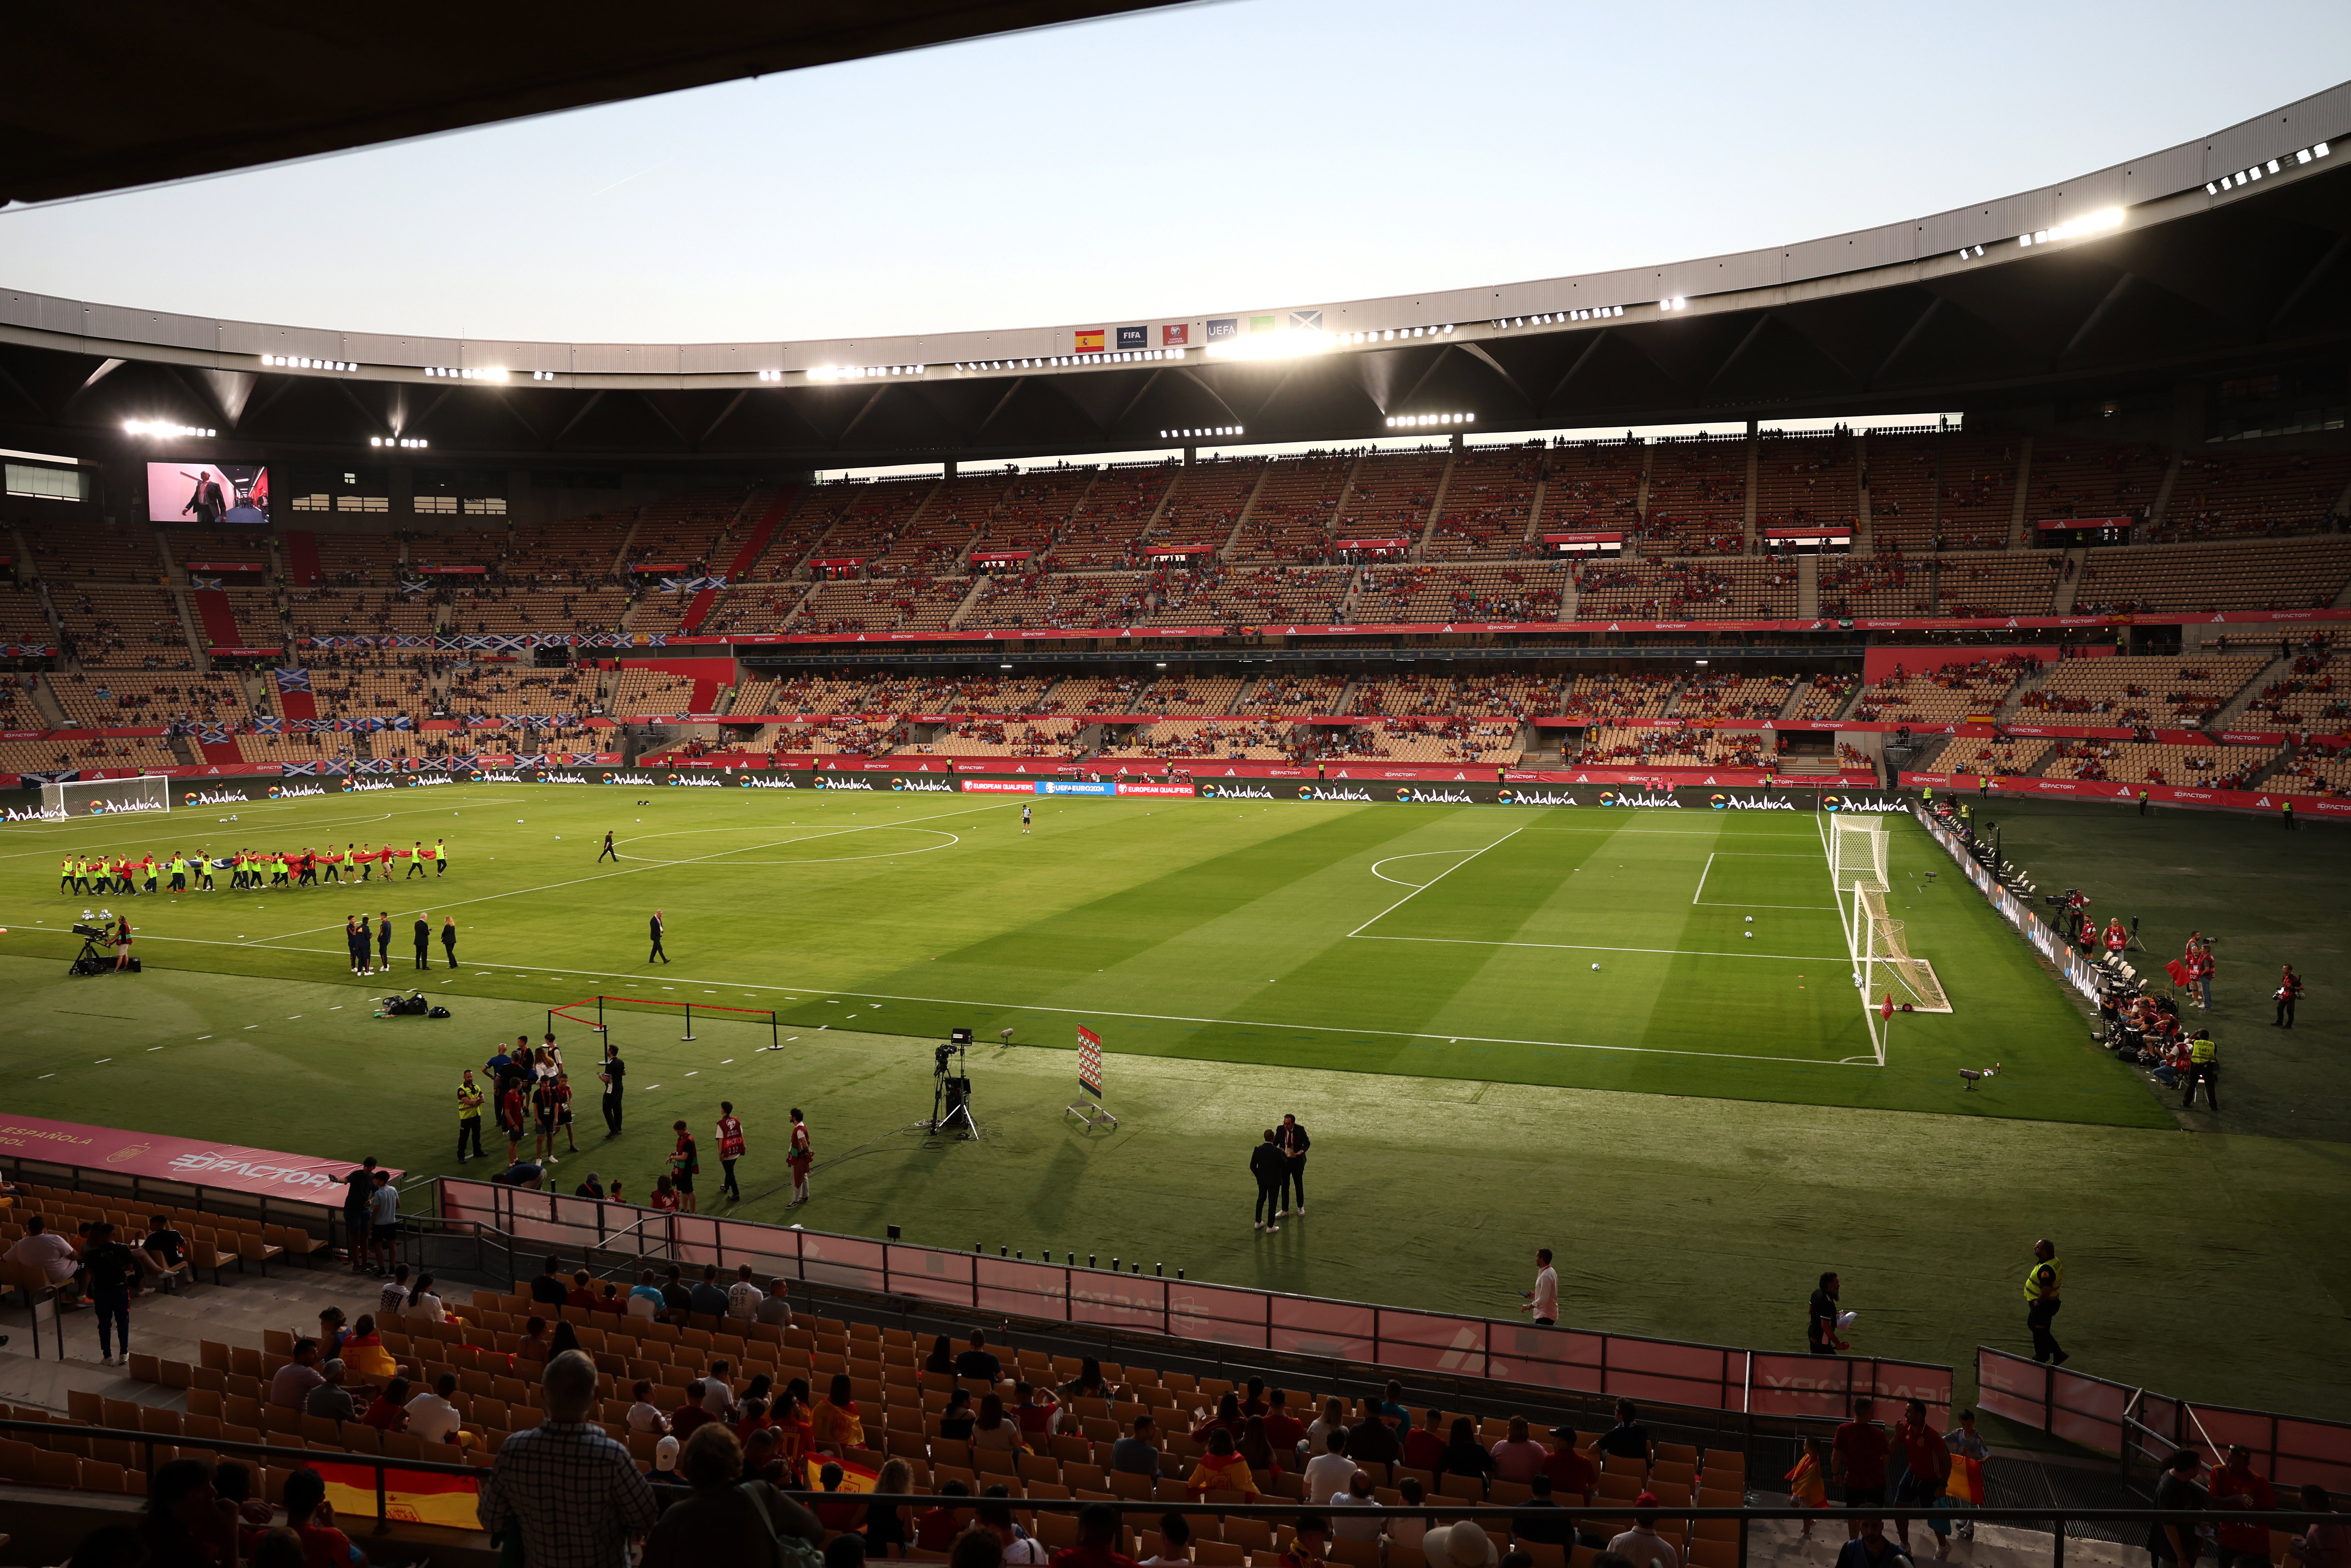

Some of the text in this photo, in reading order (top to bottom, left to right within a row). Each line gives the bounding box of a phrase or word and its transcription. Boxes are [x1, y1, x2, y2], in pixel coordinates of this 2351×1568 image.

[1208, 325, 1235, 336] UEFA
[352, 777, 395, 791] Andalucía
[417, 772, 453, 786] Andalucía
[483, 770, 522, 783] Andalucía
[547, 771, 587, 784] Andalucía
[613, 773, 655, 785] Andalucía
[678, 774, 722, 787] Andalucía
[750, 776, 796, 788] Andalucía
[280, 783, 325, 798] Andalucía
[825, 777, 873, 792] Andalucía
[903, 779, 953, 792] Andalucía
[1216, 785, 1274, 799] Andalucía
[198, 789, 249, 805] Andalucía
[1312, 786, 1373, 801] Andalucía
[1411, 788, 1474, 803] Andalucía
[1513, 790, 1578, 806] Andalucía
[1615, 792, 1681, 808] Andalucía
[104, 796, 162, 813] Andalucía
[1727, 794, 1796, 810] Andalucía
[1840, 797, 1910, 813] Andalucía
[2070, 951, 2101, 1011] Andalucía
[3, 1127, 94, 1145] ESPAÑOLA
[726, 1137, 742, 1145] PHOTO
